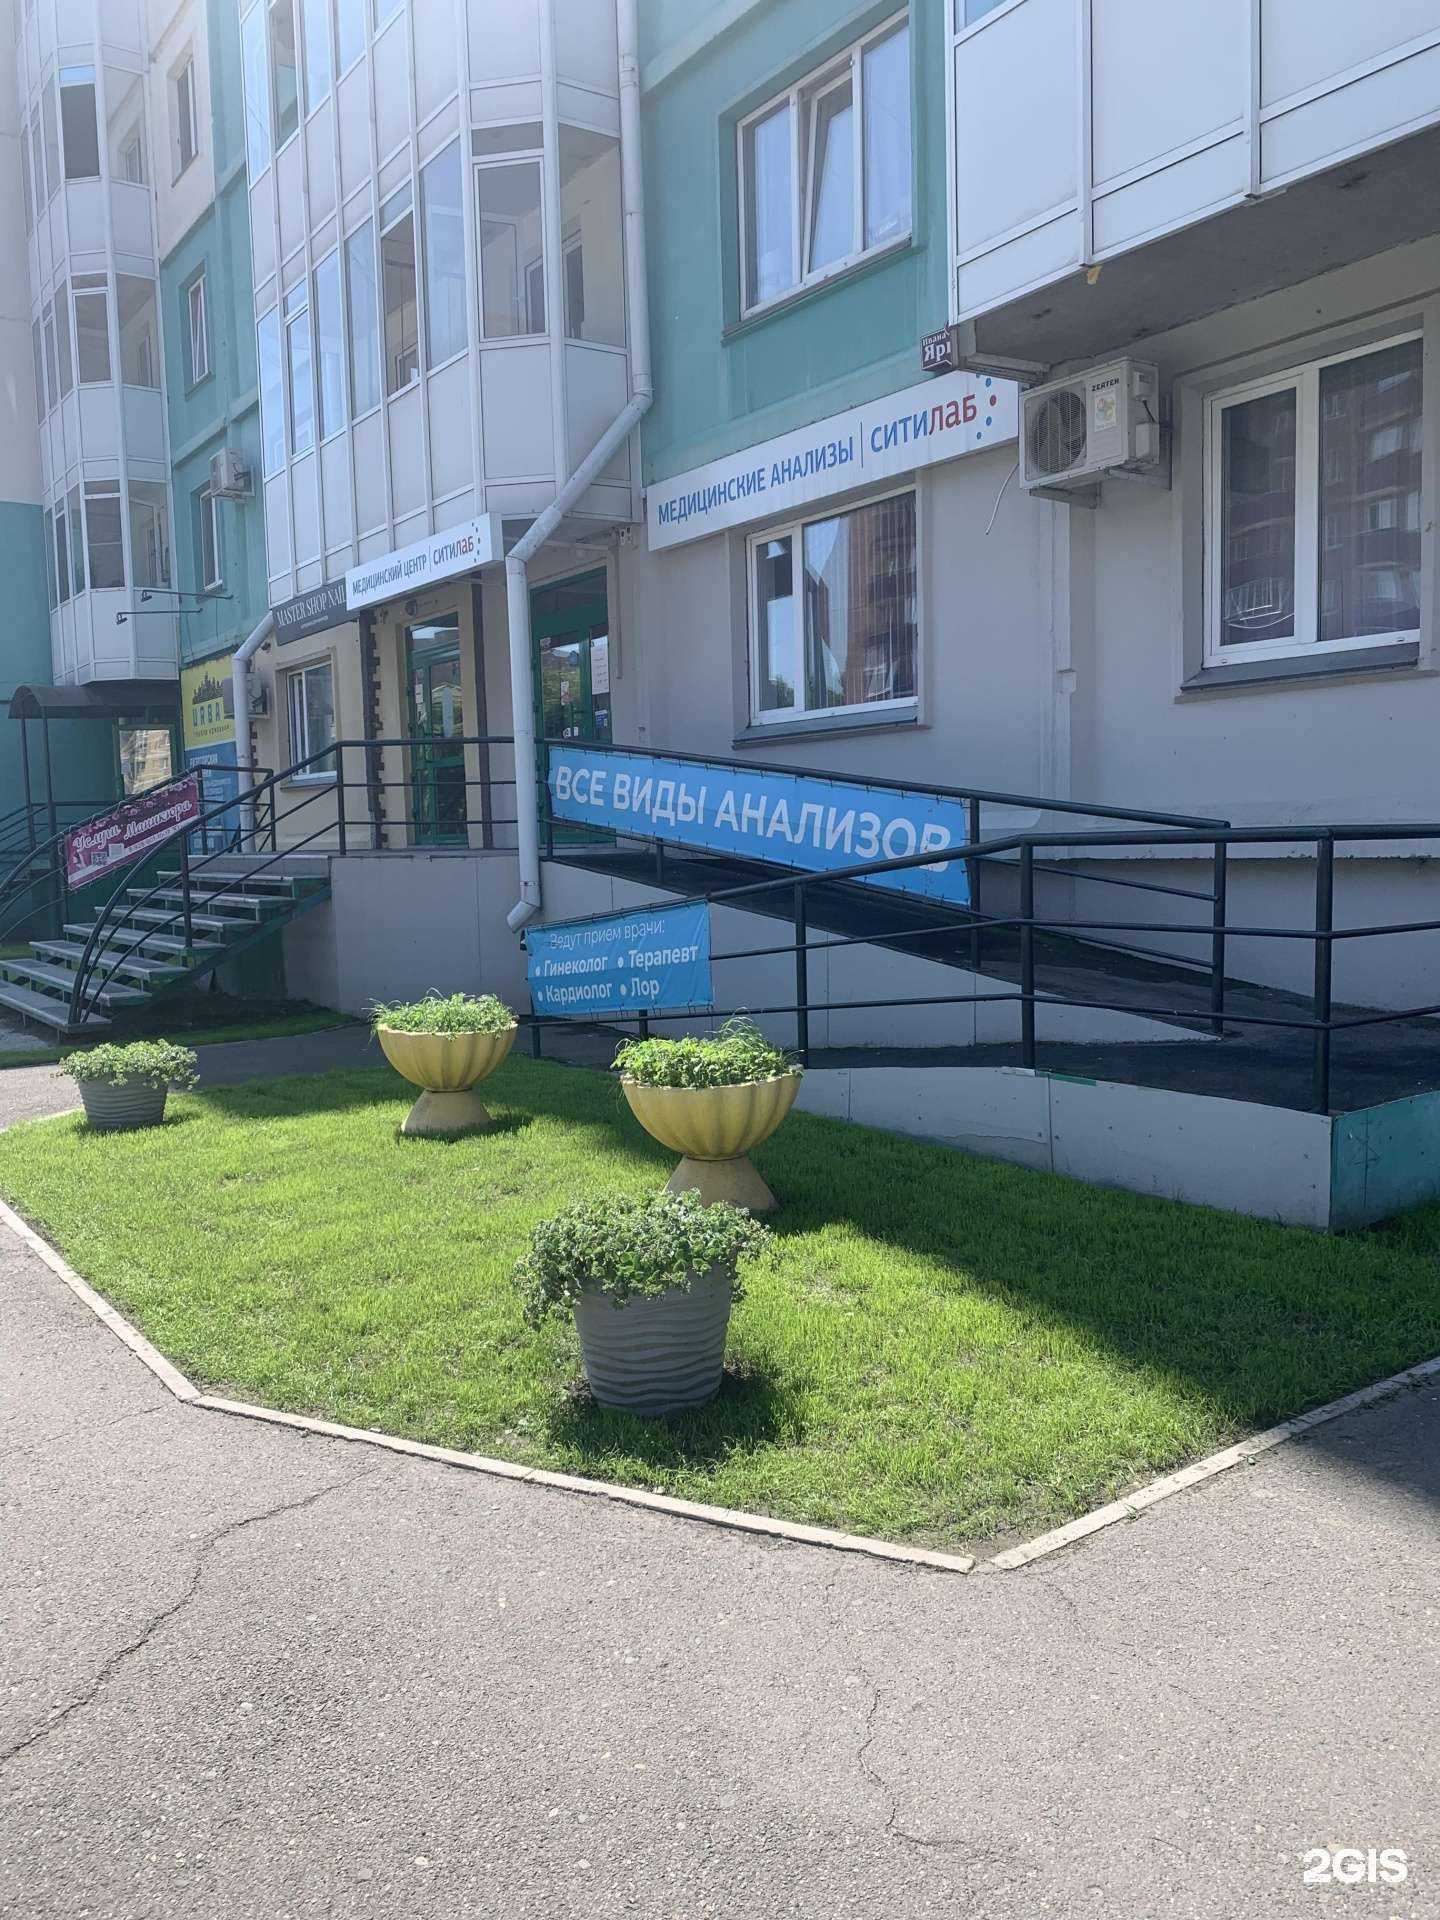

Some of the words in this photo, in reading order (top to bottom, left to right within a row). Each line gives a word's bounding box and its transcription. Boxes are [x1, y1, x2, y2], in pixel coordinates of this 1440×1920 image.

[658, 468, 766, 525] МЕДИЦИНСКИЕ
[771, 437, 854, 487] АНАЛИЗЫ
[352, 560, 403, 596] МЕДИЦИНСКИЙ
[403, 553, 428, 579] ЦЕНТР
[276, 602, 306, 626] MASTER
[305, 593, 327, 616] SHOP
[556, 766, 607, 806] ВСЕ
[613, 773, 707, 827] ВИДЫ
[714, 790, 951, 873] АНАЛИЗОВ
[583, 929, 621, 946] прием
[624, 919, 666, 941] врачи:
[543, 955, 609, 977] Гинеколог
[628, 945, 699, 972] Терапевт
[545, 982, 613, 1006] Кардиолог
[630, 977, 660, 1000] Лор
